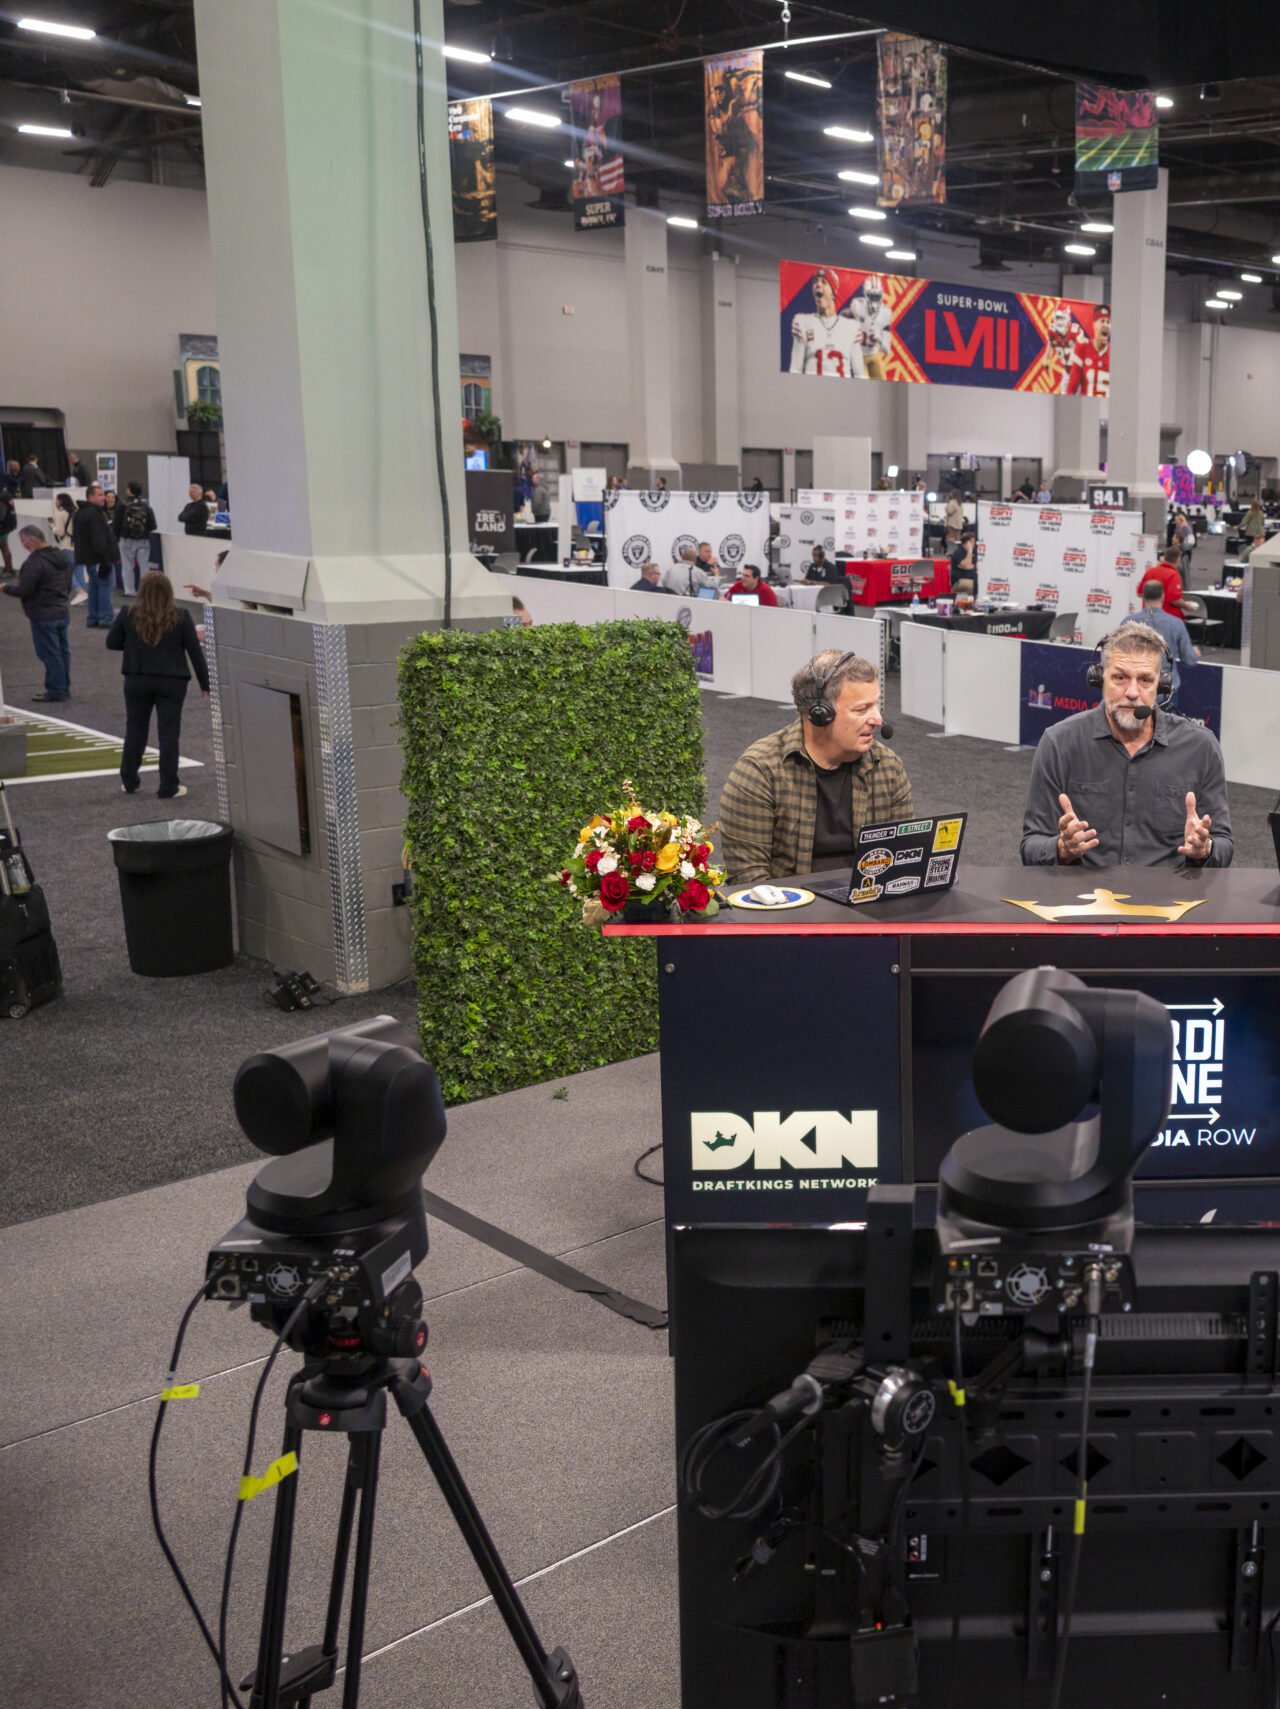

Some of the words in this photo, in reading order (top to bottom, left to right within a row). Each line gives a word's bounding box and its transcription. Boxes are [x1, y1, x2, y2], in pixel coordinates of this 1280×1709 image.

[585, 202, 611, 213] SUPER
[707, 204, 733, 218] SUPER
[937, 292, 973, 310] SUPER
[977, 300, 1010, 314] BOWL
[924, 309, 1020, 372] LVIII
[1093, 490, 1125, 507] 94.1
[475, 522, 506, 533] LAND
[1053, 696, 1089, 711] MEDIA
[907, 822, 929, 832] STREET
[863, 830, 888, 841] THUNDER
[897, 849, 923, 861] DKN
[1171, 1063, 1223, 1104] NE
[690, 1110, 879, 1171] DKN
[1197, 1128, 1256, 1146] ROW
[692, 1179, 794, 1191] DRAFTKINGS
[799, 1178, 878, 1190] NETWORK
